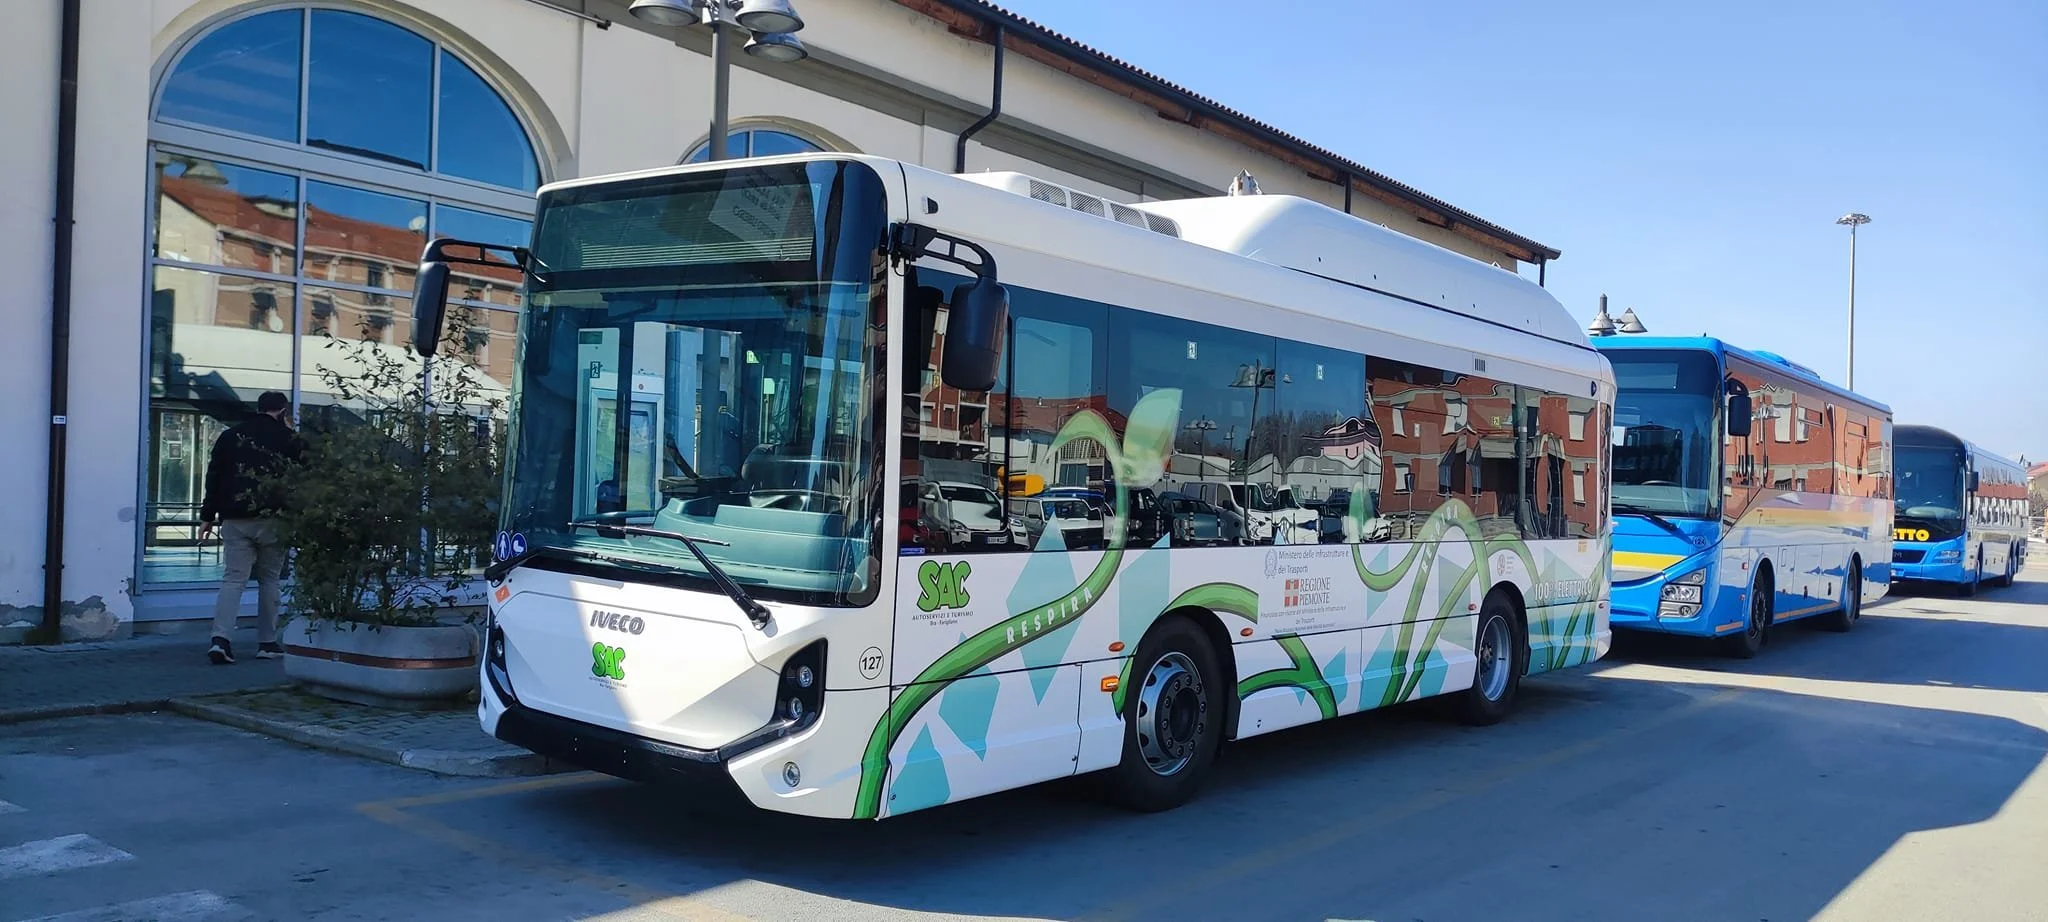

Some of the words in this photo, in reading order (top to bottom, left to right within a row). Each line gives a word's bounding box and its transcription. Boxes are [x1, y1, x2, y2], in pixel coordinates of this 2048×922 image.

[917, 560, 971, 612] SAC
[1300, 577, 1331, 592] REGIONE
[1299, 592, 1330, 606] PIEMONTE
[590, 610, 645, 635] IVECO
[912, 613, 946, 621] AUTOSERVIZI
[1007, 587, 1092, 644] RESPIRA
[592, 642, 625, 680] SAC
[862, 656, 882, 671] 127
